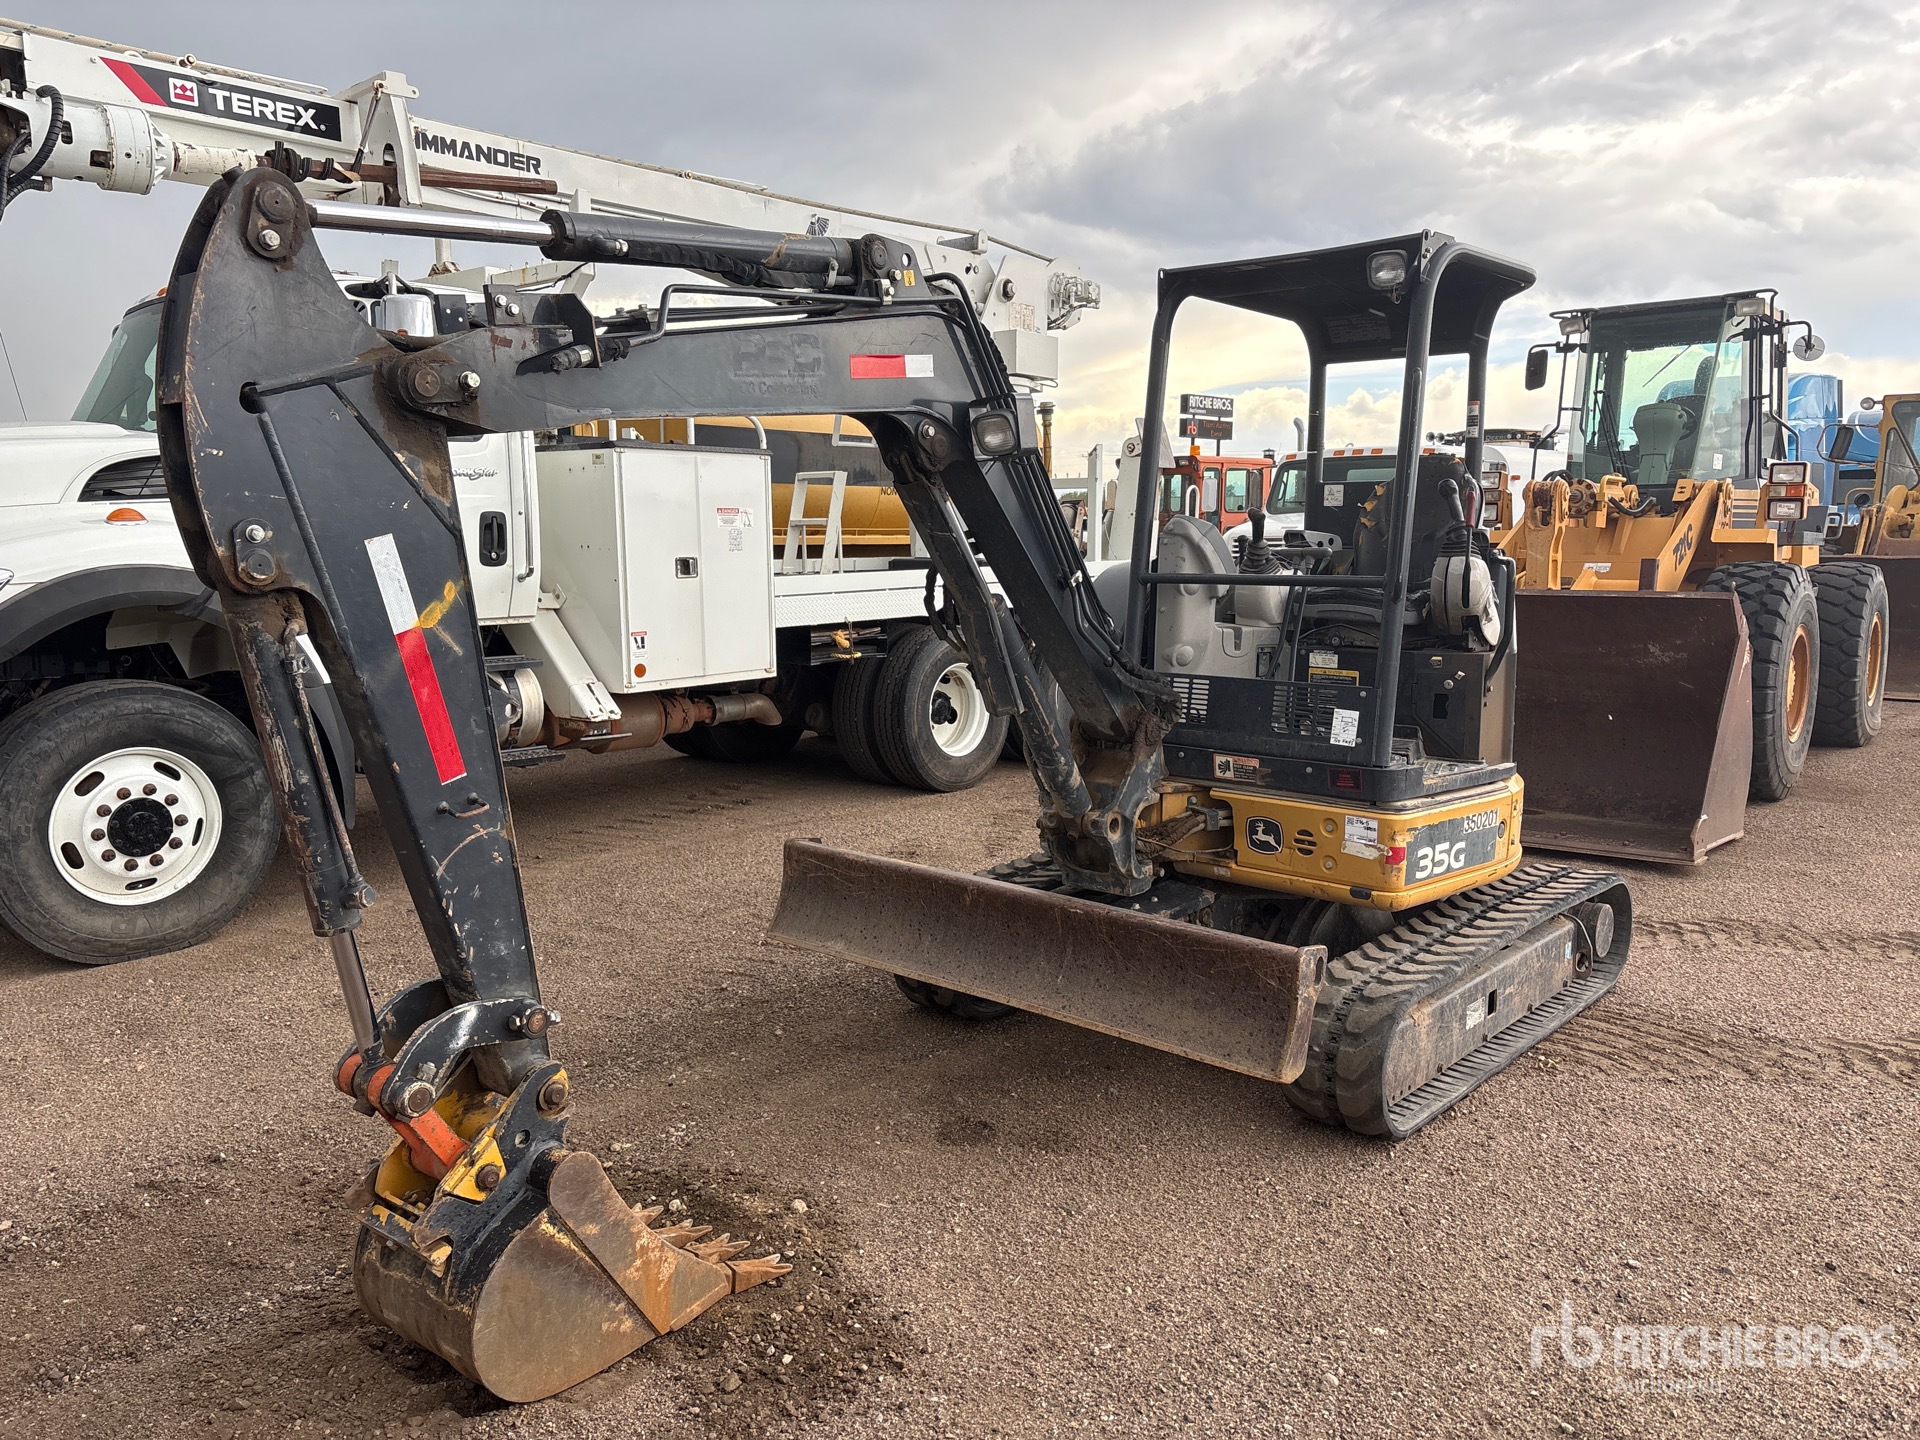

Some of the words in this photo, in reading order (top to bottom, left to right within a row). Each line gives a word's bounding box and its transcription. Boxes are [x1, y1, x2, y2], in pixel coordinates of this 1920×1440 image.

[207, 88, 318, 130] TEREX
[415, 131, 541, 175] MMANDER
[1190, 395, 1212, 409] RITCHIE
[1213, 397, 1233, 410] BROS.
[1187, 421, 1198, 435] rb
[1464, 809, 1498, 832] 350201
[110, 777, 254, 935] GOODYEAR
[1415, 841, 1466, 879] 35G
